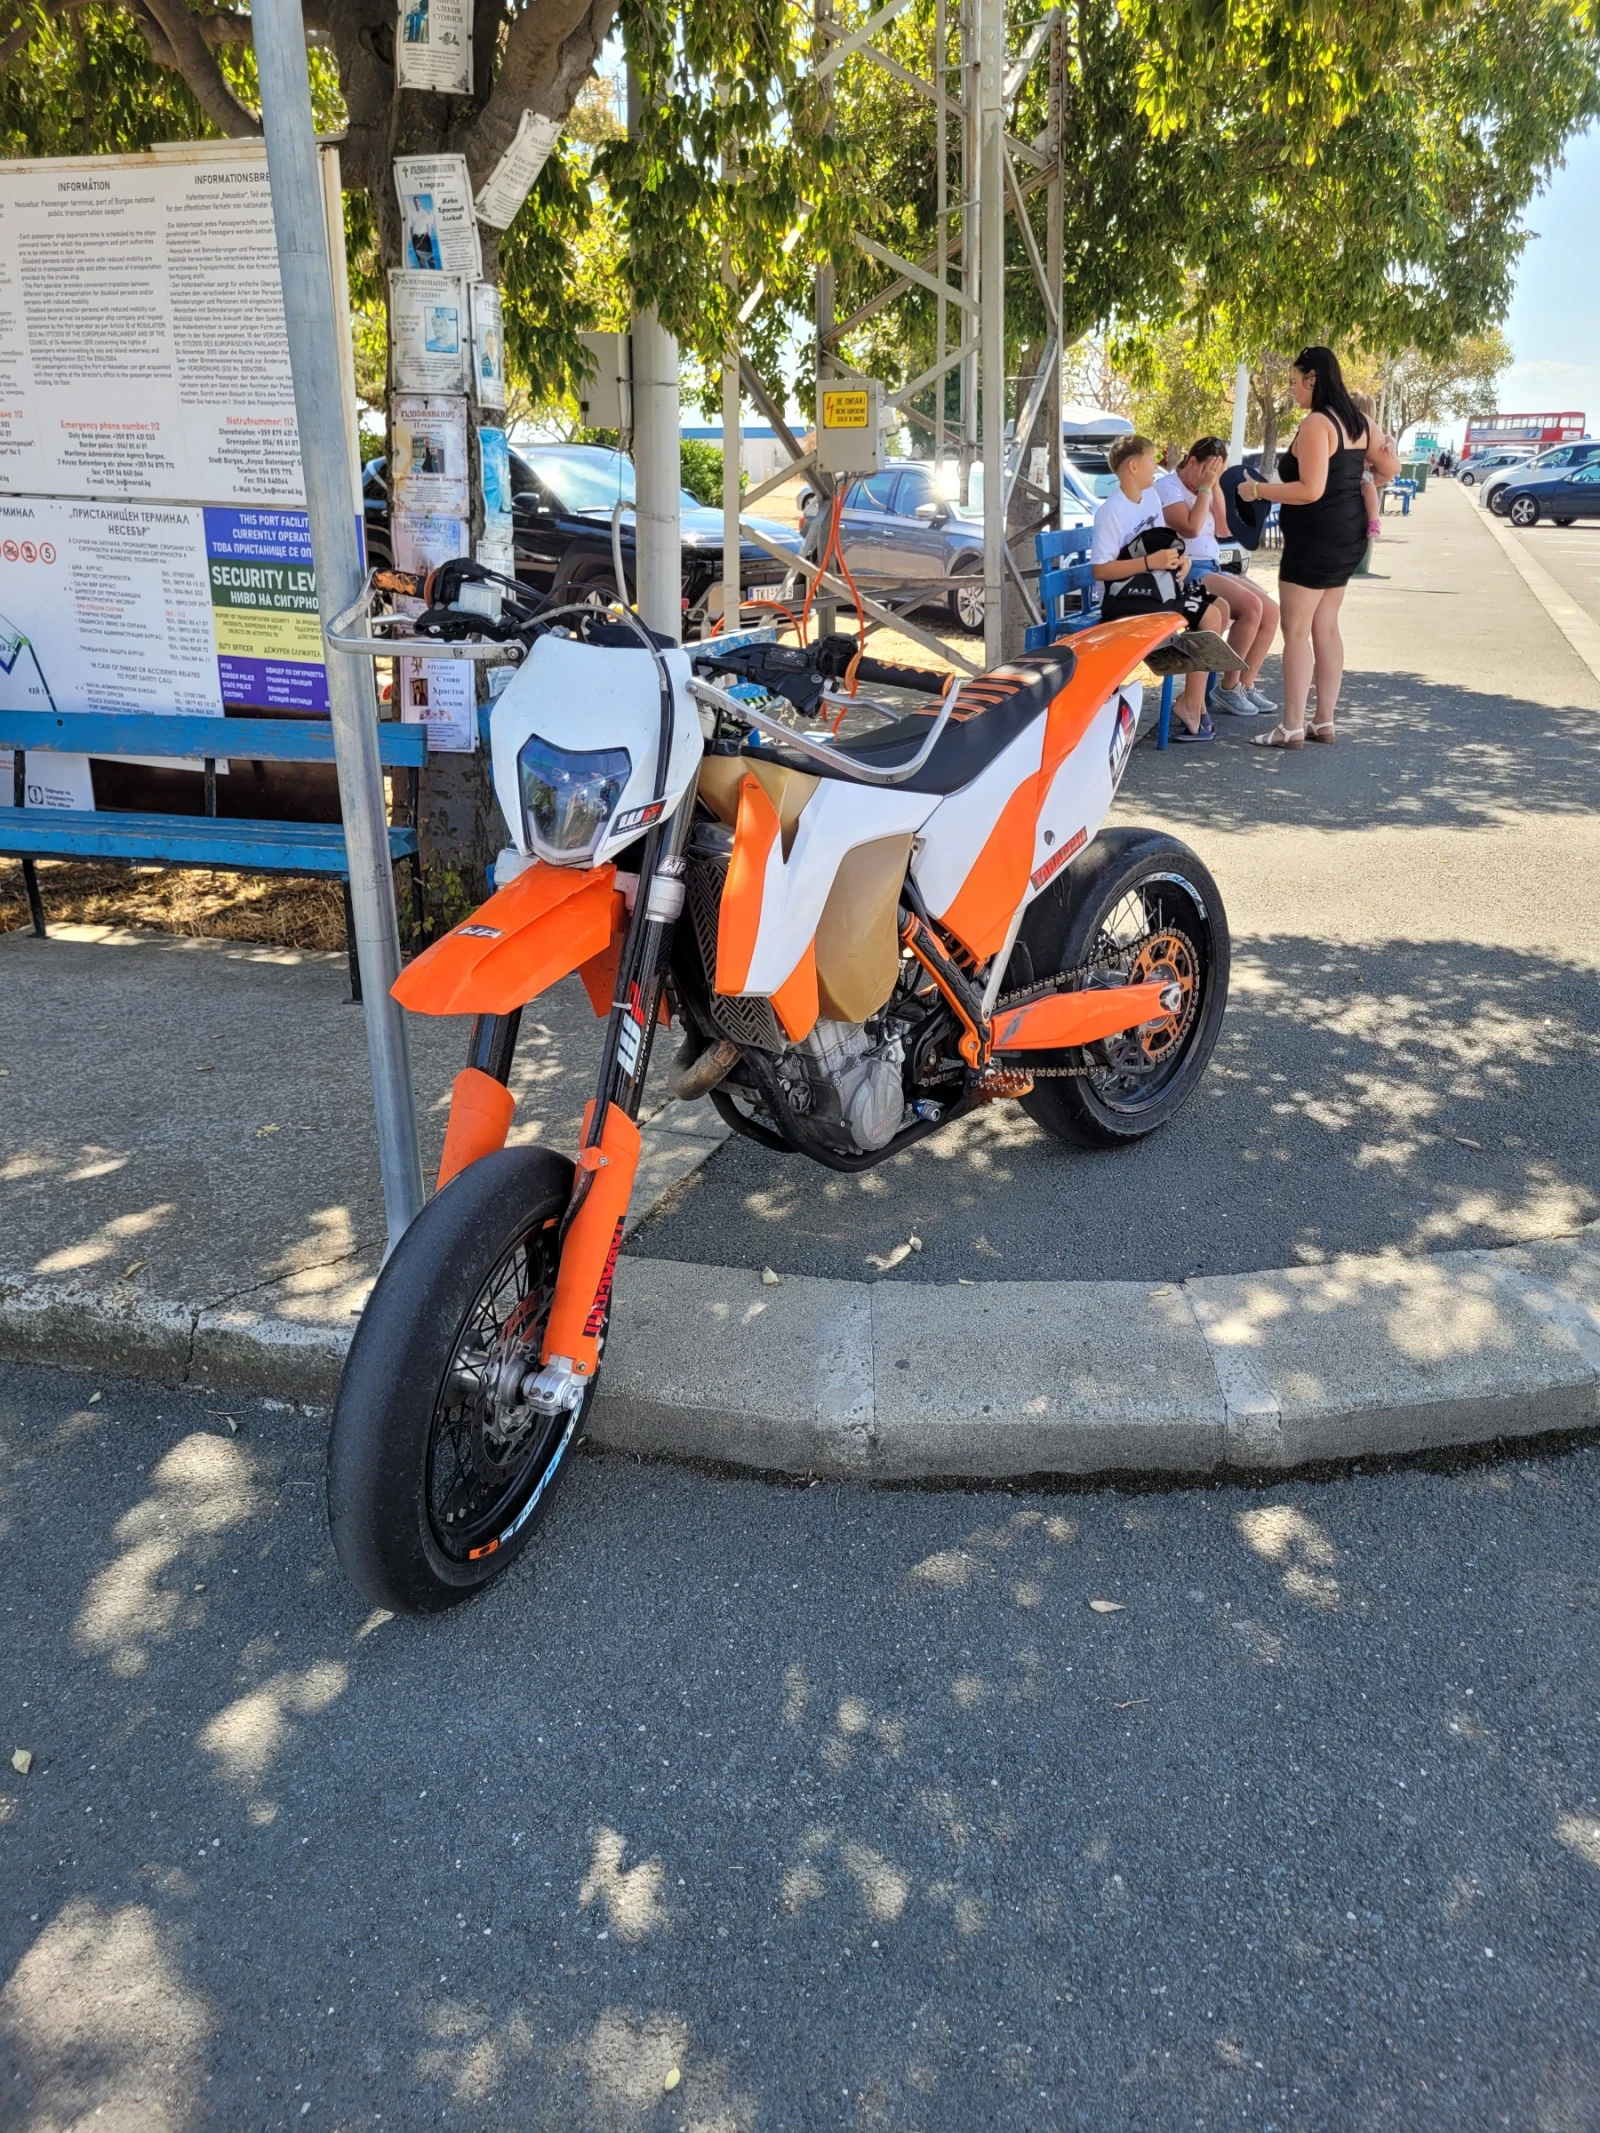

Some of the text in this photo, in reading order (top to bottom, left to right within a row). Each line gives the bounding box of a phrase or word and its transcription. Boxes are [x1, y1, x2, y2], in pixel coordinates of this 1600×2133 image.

[194, 172, 270, 184] INFORMATIONSBRE
[58, 181, 111, 192] INFORMATION
[41, 200, 69, 208] Passenger
[96, 199, 107, 207] part
[114, 198, 133, 206] Burgas
[65, 209, 103, 217] transportation
[104, 208, 125, 216] seaport
[60, 420, 98, 431] Emergency
[100, 422, 120, 431] phone
[151, 422, 161, 431] 112
[283, 417, 294, 426] 112
[127, 452, 144, 460] Agency
[141, 511, 190, 525] ТЕРМИНАЛ
[239, 514, 309, 528] THIS PORT FACILIT
[232, 528, 310, 543] CURRENTLY OPERATI
[212, 542, 311, 558] ТОВА ПРИСТАНИЩЕ СЕ ОП
[211, 565, 317, 592] SECURITY LEV
[230, 591, 319, 610] НИВО НА СИГУРНО
[232, 643, 253, 652] OFFICER
[263, 647, 321, 657] ДЕЖУРЕН СЛУЖИТЕЛ
[120, 664, 138, 672] THREAT
[178, 670, 201, 678] RELATED
[221, 672, 255, 682] BORDER POLICE
[436, 675, 460, 683] Стоян
[29, 687, 40, 695] КЕЙ
[222, 681, 252, 691] STATE POLICE
[432, 687, 464, 696] Христов
[223, 690, 244, 699] CUSTOMS
[618, 804, 662, 830] WP
[1032, 828, 1087, 888] TABACCHI
[584, 1224, 625, 1334] TABACCHI
